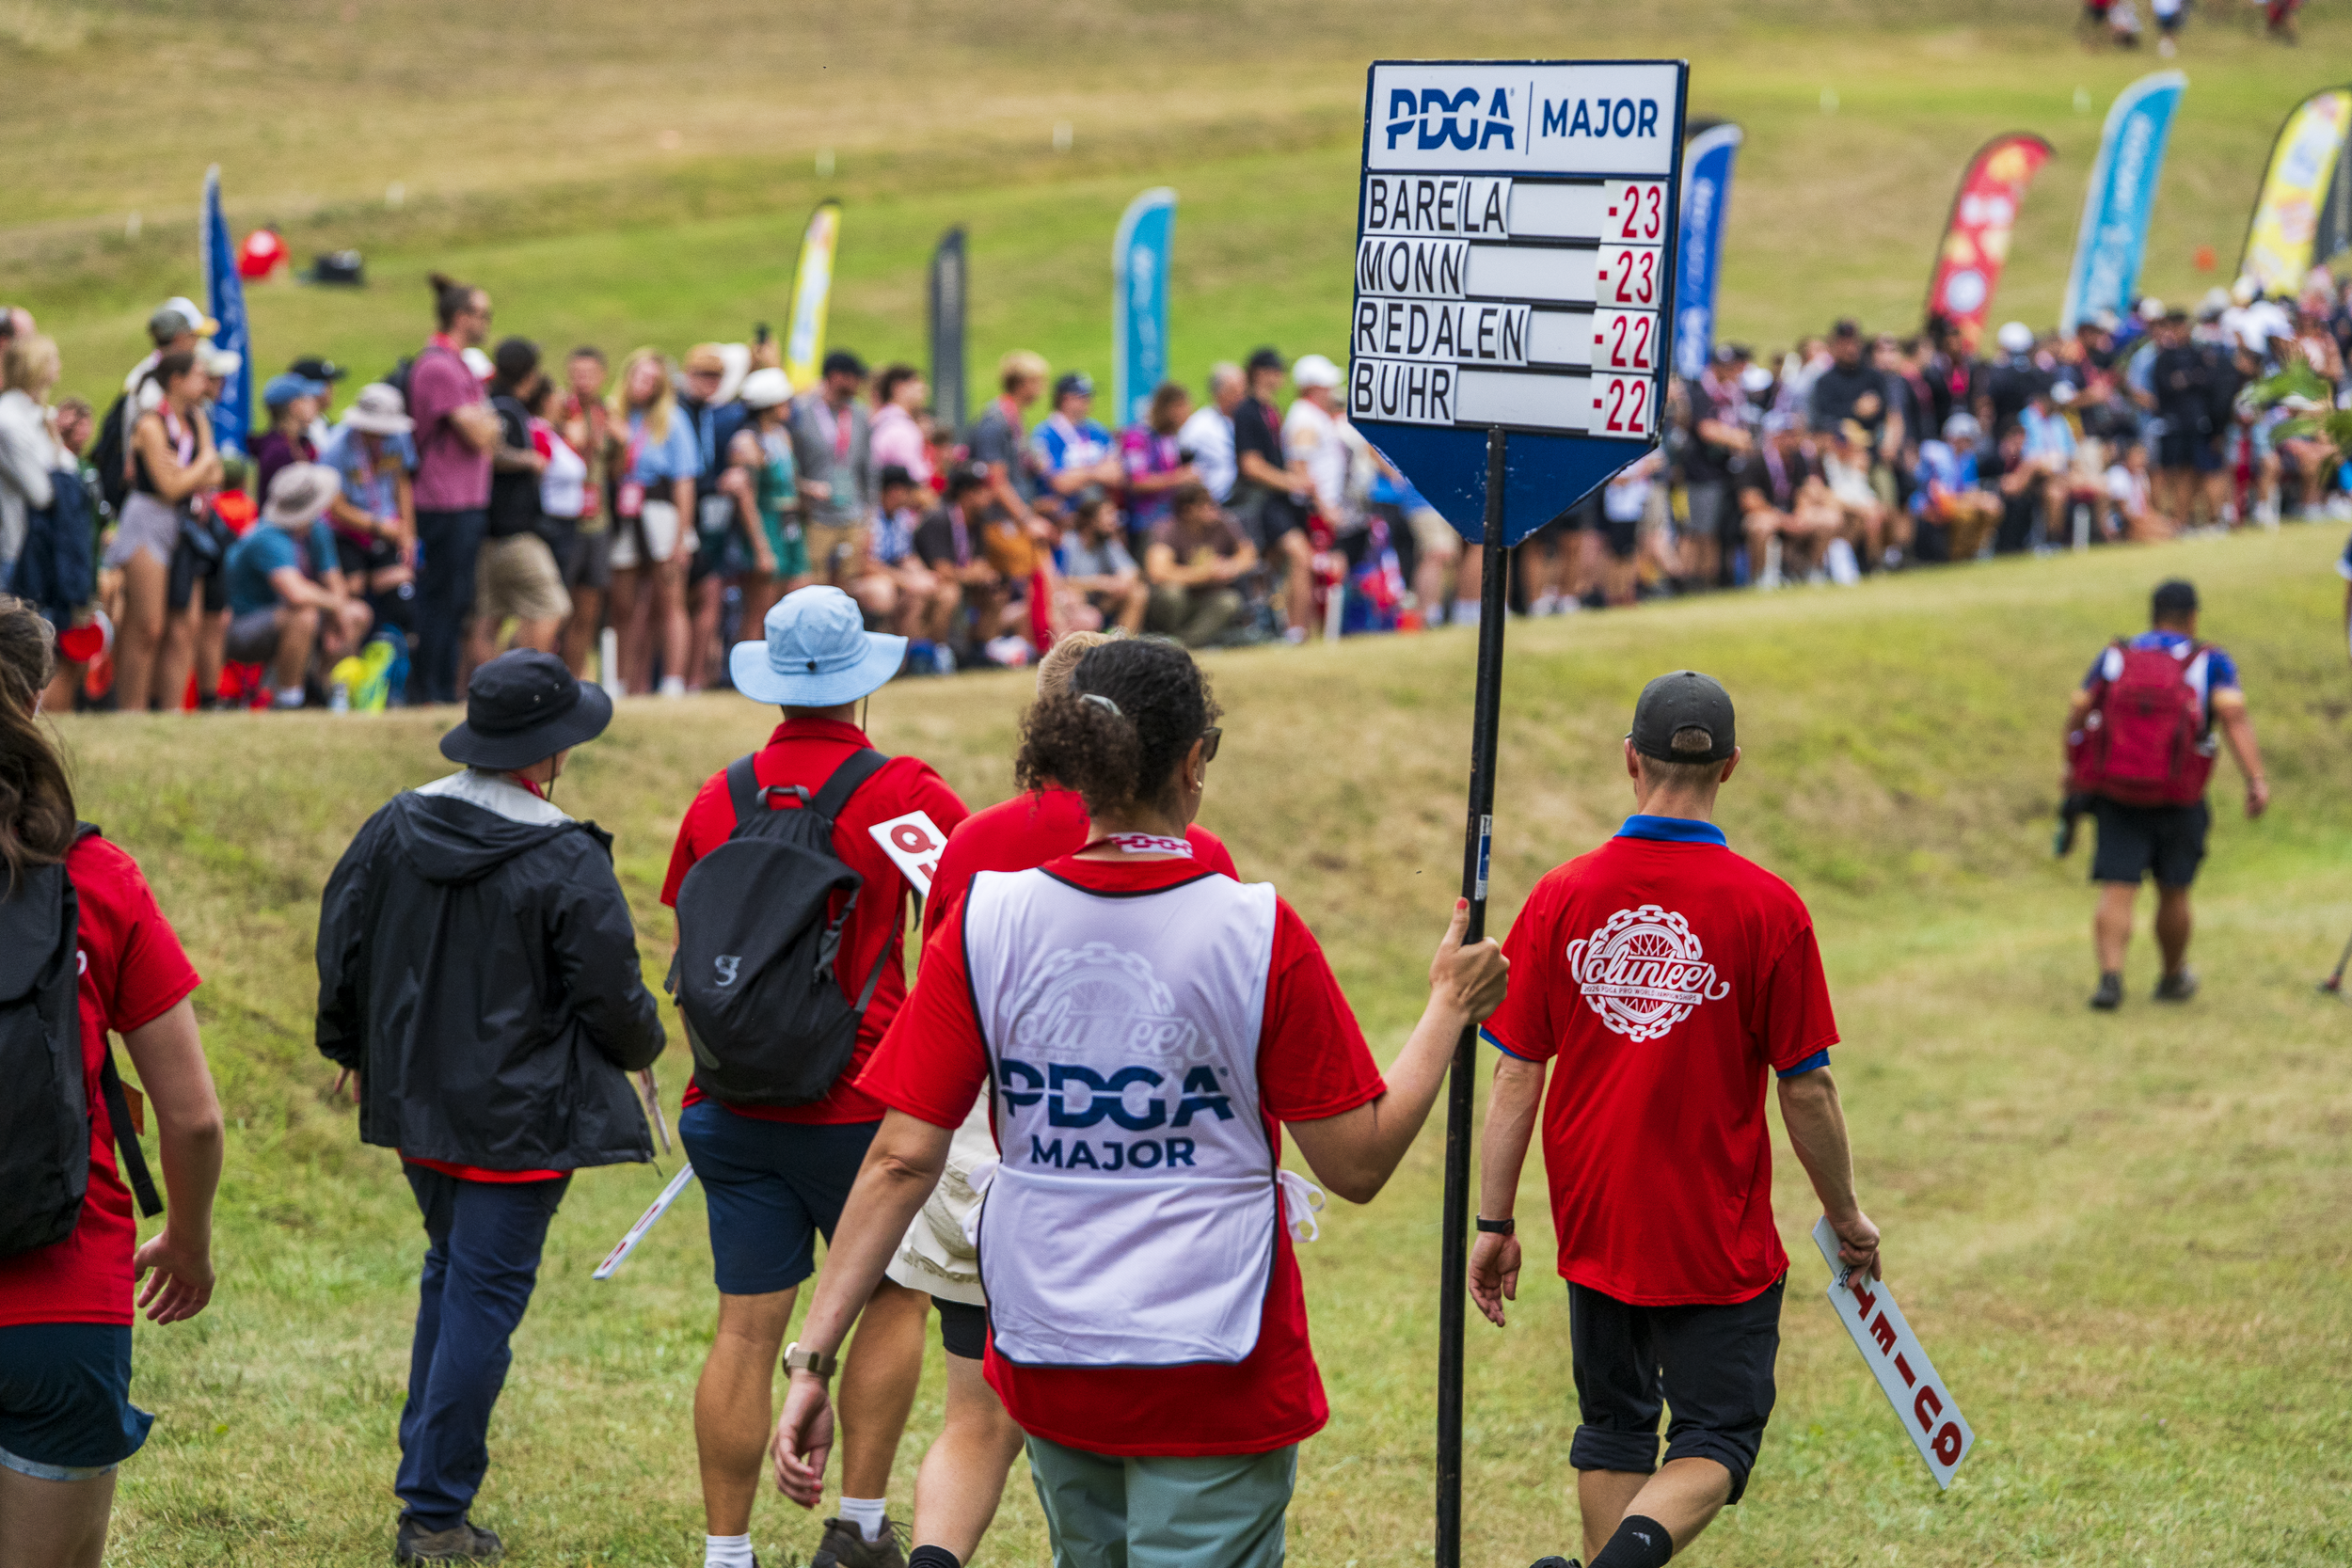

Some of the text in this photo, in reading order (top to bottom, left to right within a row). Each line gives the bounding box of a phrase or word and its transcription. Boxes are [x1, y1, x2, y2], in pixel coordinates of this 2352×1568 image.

[1386, 87, 1659, 150] PDGA MAJOR
[1368, 178, 1661, 239] BARELA -23
[1359, 240, 1654, 304] MONN -23
[1358, 301, 1526, 360] REDALEN
[1595, 314, 1650, 368] -22
[1355, 362, 1646, 433] BUHR -22
[1566, 939, 1730, 1001] Volunteer
[1000, 1057, 1234, 1131] PDGA
[1031, 1134, 1197, 1172] MAJOR
